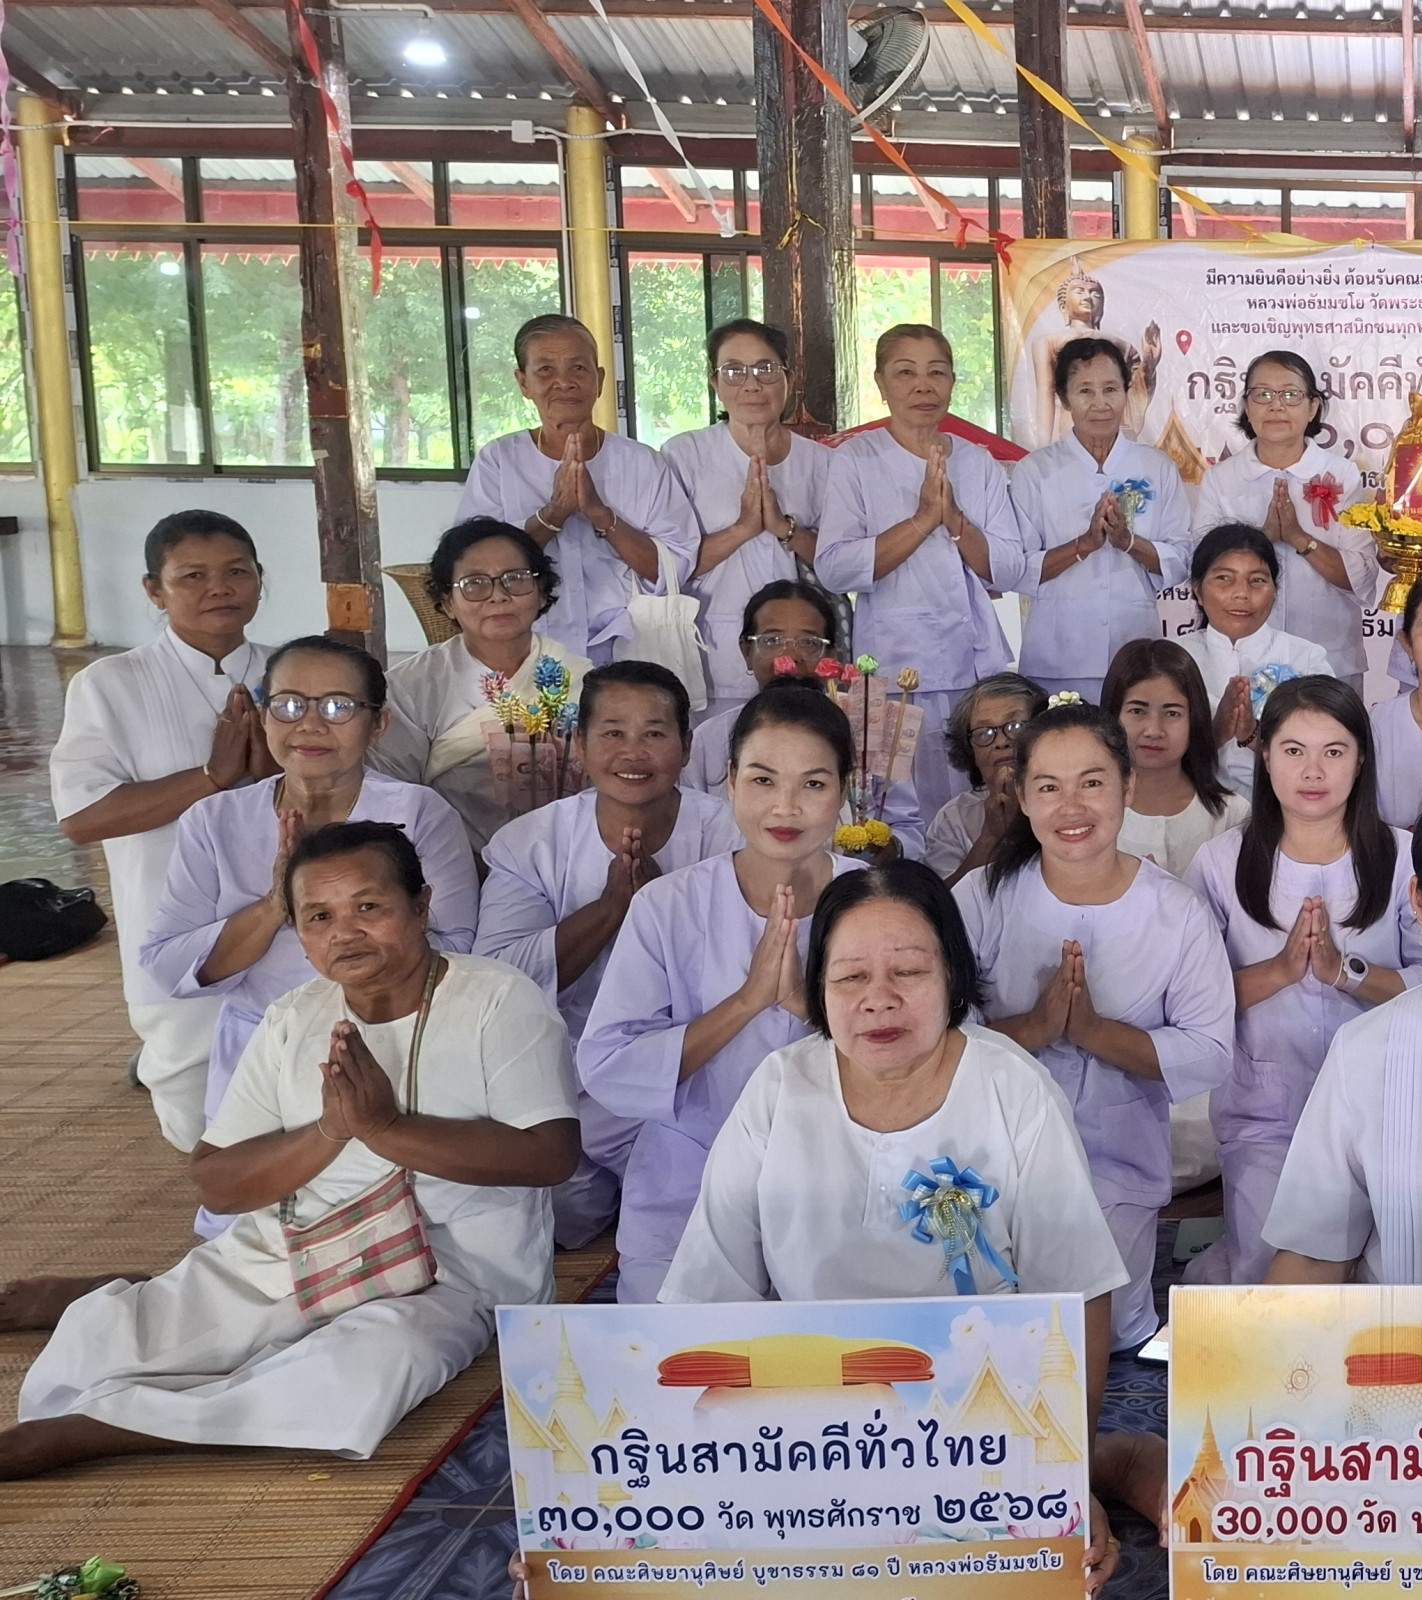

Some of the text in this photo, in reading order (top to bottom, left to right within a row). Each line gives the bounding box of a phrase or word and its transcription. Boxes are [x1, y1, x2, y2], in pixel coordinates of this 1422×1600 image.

[1246, 291, 1365, 310] หลวงพ่อธัมมชโย
[591, 1410, 1008, 1489] กฐินสามัคคีทั่วไทย
[538, 1488, 1068, 1540] ๓๐,๐๐๐ วัด พุทธศักราช ๒๕๖๘
[1217, 1507, 1347, 1538] 30,000
[1357, 1501, 1397, 1533] วัด
[549, 1562, 585, 1580] โดย
[594, 1560, 744, 1586] คณะศิษยานุศิษย์
[753, 1564, 844, 1585] บูชาธรรม
[888, 1557, 900, 1576] ปี
[909, 1549, 1062, 1575] หลวงพ่อธัมมชโย
[1203, 1559, 1237, 1581] โดย
[1246, 1561, 1391, 1588] คณะศิษยานุศิษย์
